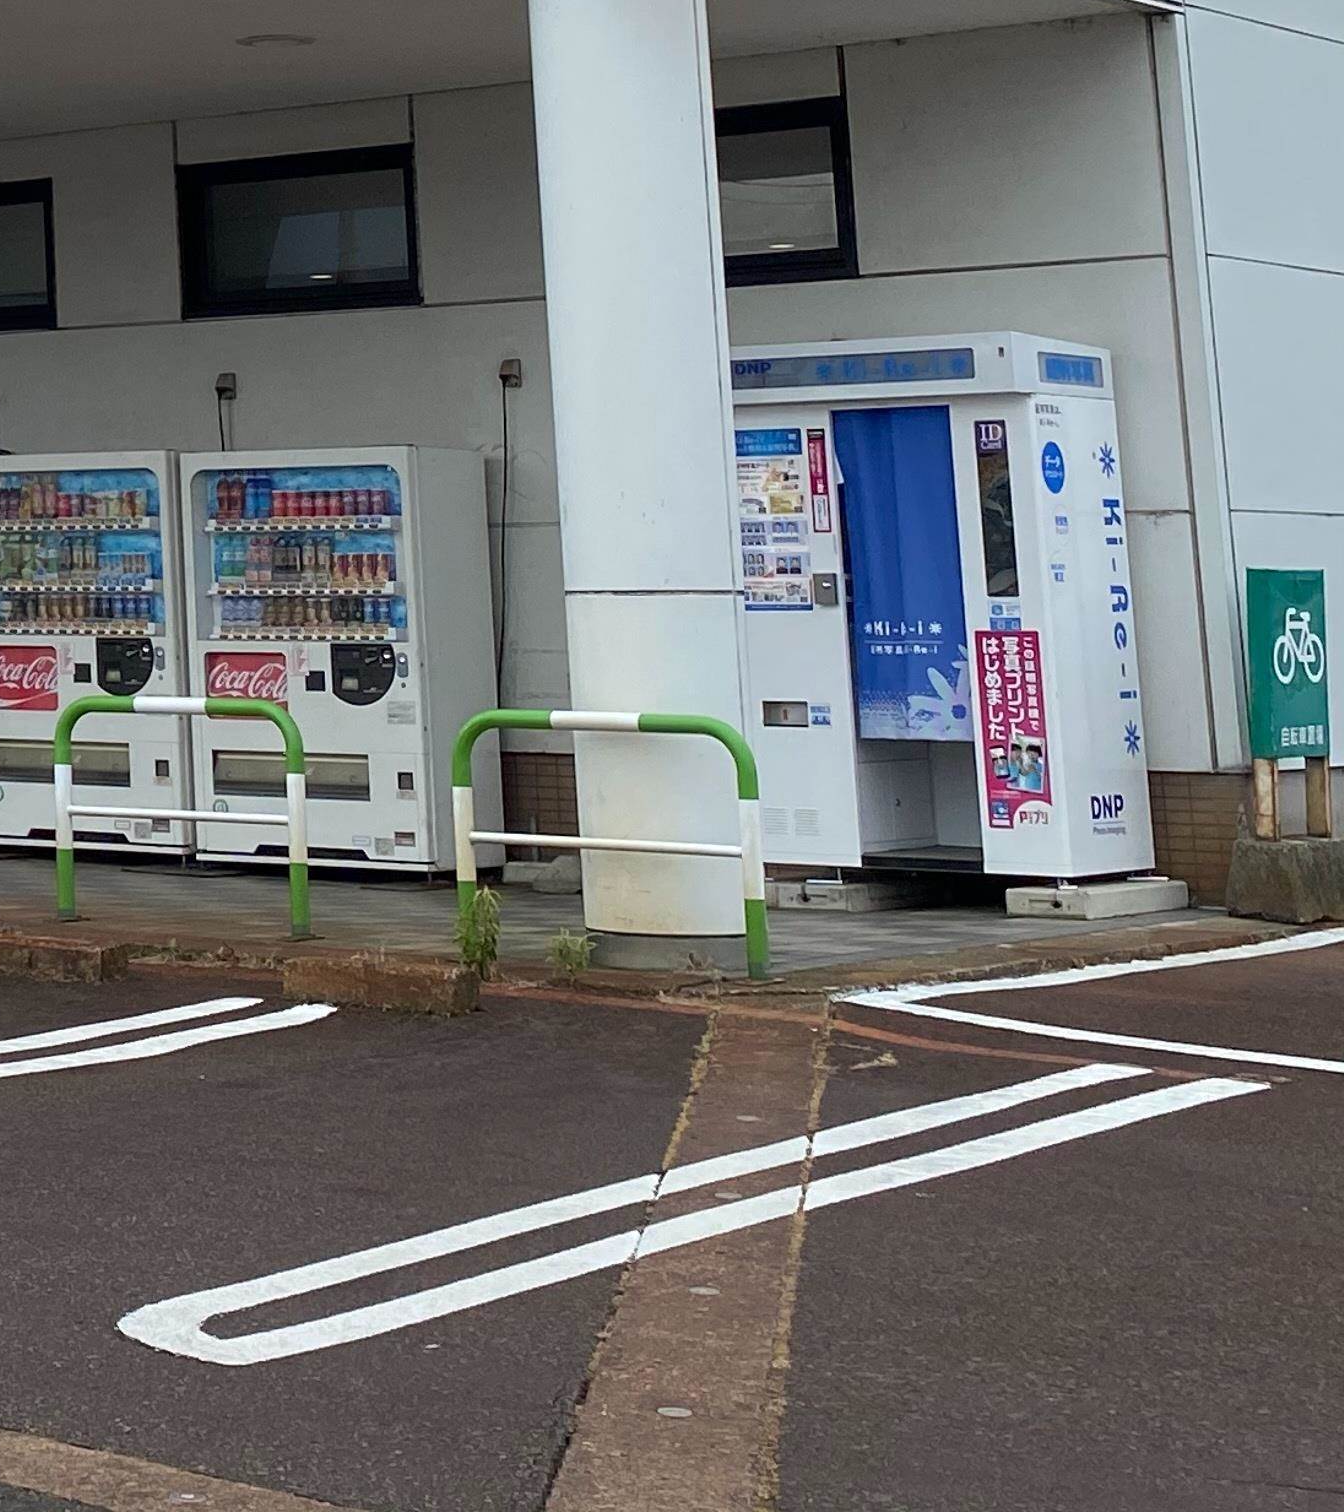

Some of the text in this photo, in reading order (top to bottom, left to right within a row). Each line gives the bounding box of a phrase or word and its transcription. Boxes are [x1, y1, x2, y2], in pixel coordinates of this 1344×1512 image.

[735, 361, 772, 376] DNP
[979, 423, 1003, 441] ID
[982, 636, 1007, 740] はじめました
[1002, 636, 1025, 740] 写真プリント
[1090, 794, 1124, 820] DNP
